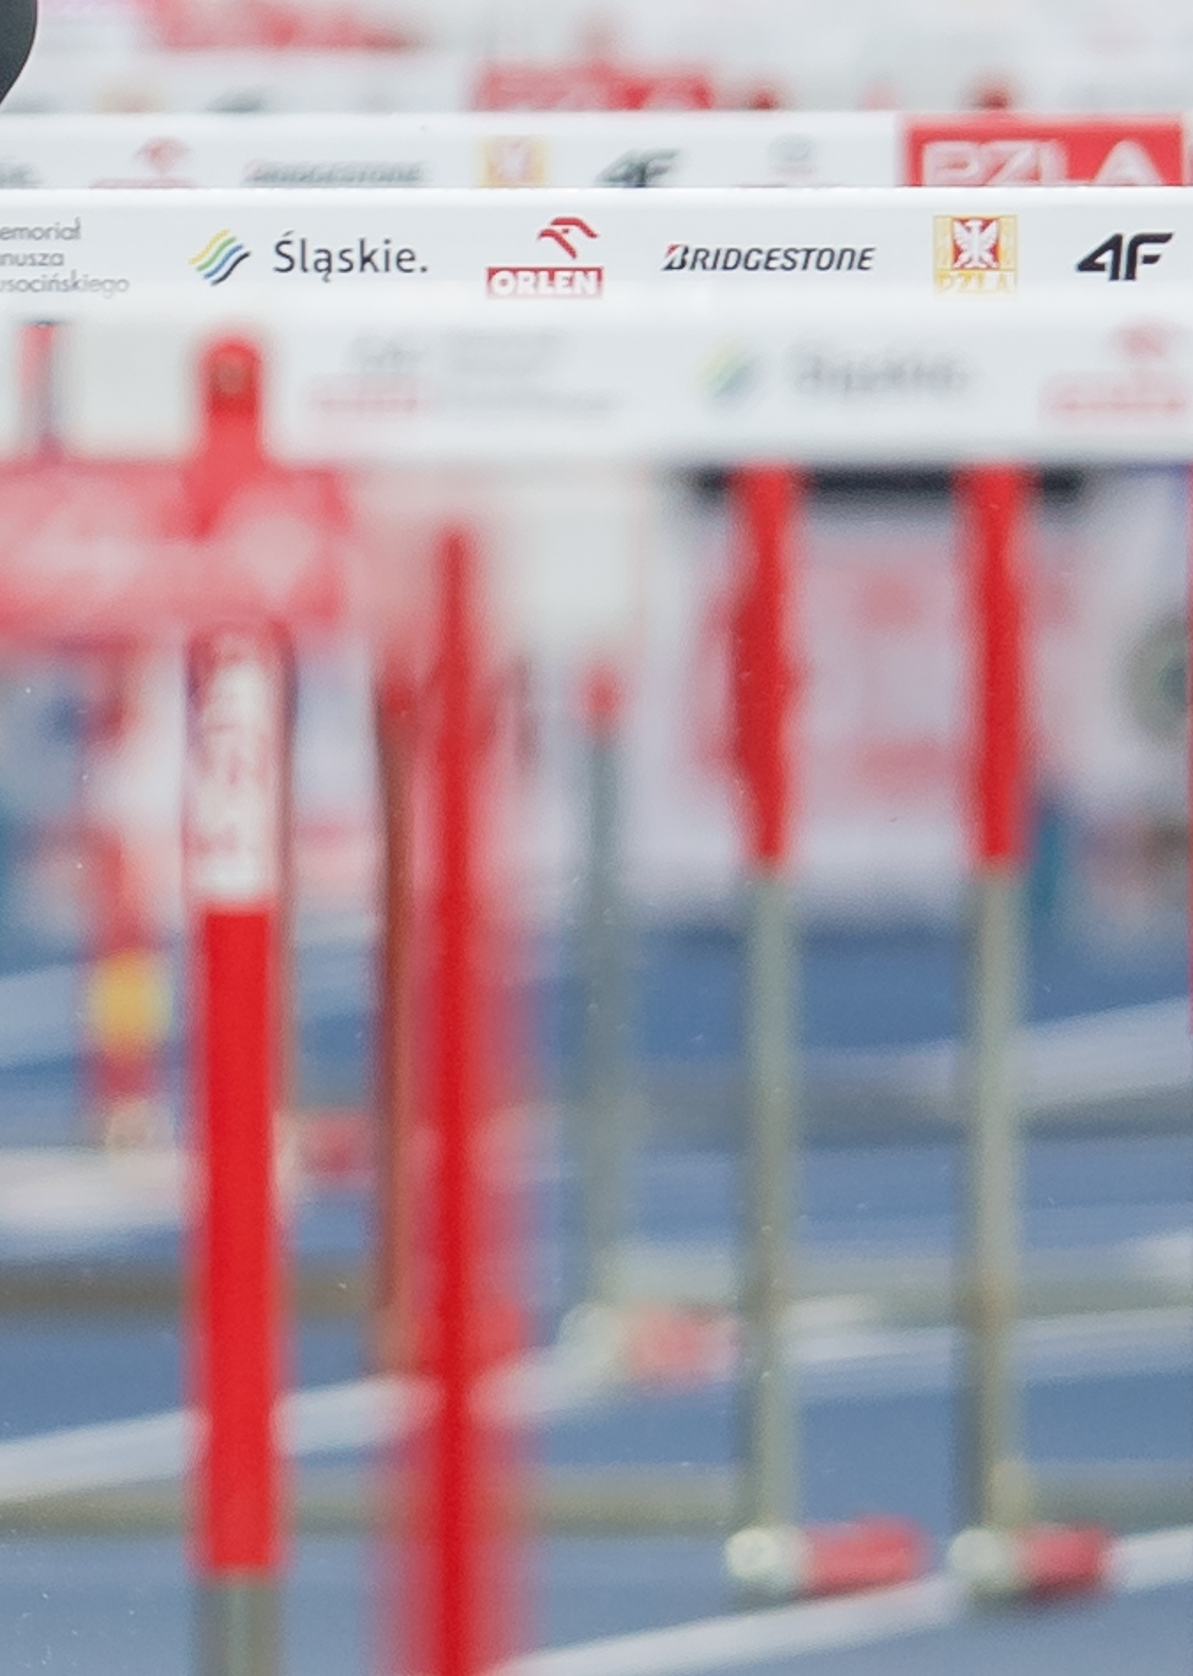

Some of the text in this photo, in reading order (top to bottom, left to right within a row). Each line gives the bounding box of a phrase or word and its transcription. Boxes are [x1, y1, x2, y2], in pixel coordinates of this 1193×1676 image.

[272, 230, 429, 282] Śląskie.
[661, 243, 877, 272] BRIDGESTONE
[1074, 232, 1175, 282] 4F
[489, 271, 598, 295] ORLEN
